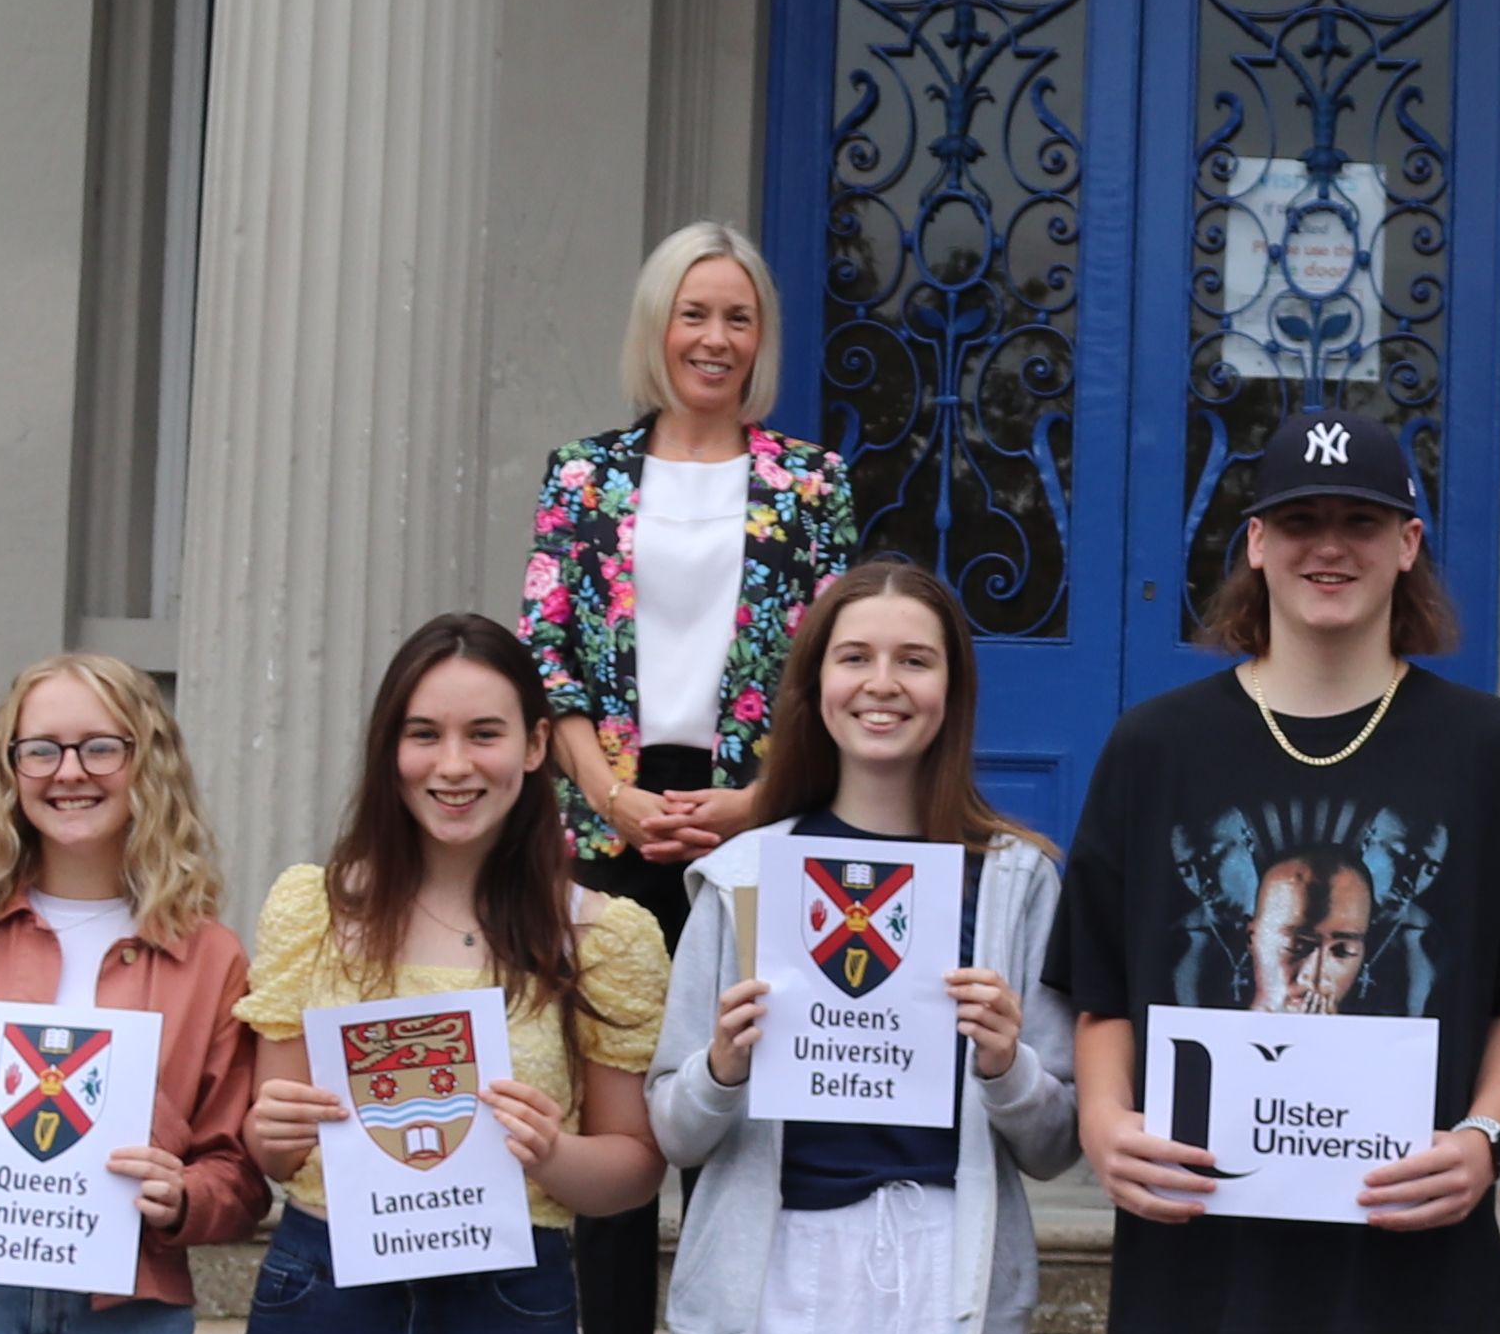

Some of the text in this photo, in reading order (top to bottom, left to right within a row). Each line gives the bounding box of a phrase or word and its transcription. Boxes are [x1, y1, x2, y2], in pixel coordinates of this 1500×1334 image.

[1304, 246, 1331, 257] use
[1304, 261, 1349, 278] door
[1304, 422, 1351, 465] NY
[810, 1002, 900, 1031] Queen's
[794, 1036, 914, 1072] University
[811, 1072, 895, 1099] Belfast
[1253, 1097, 1349, 1128] Ulster
[1252, 1127, 1412, 1161] University
[371, 1185, 486, 1215] Lancaster
[372, 1222, 492, 1256] University
